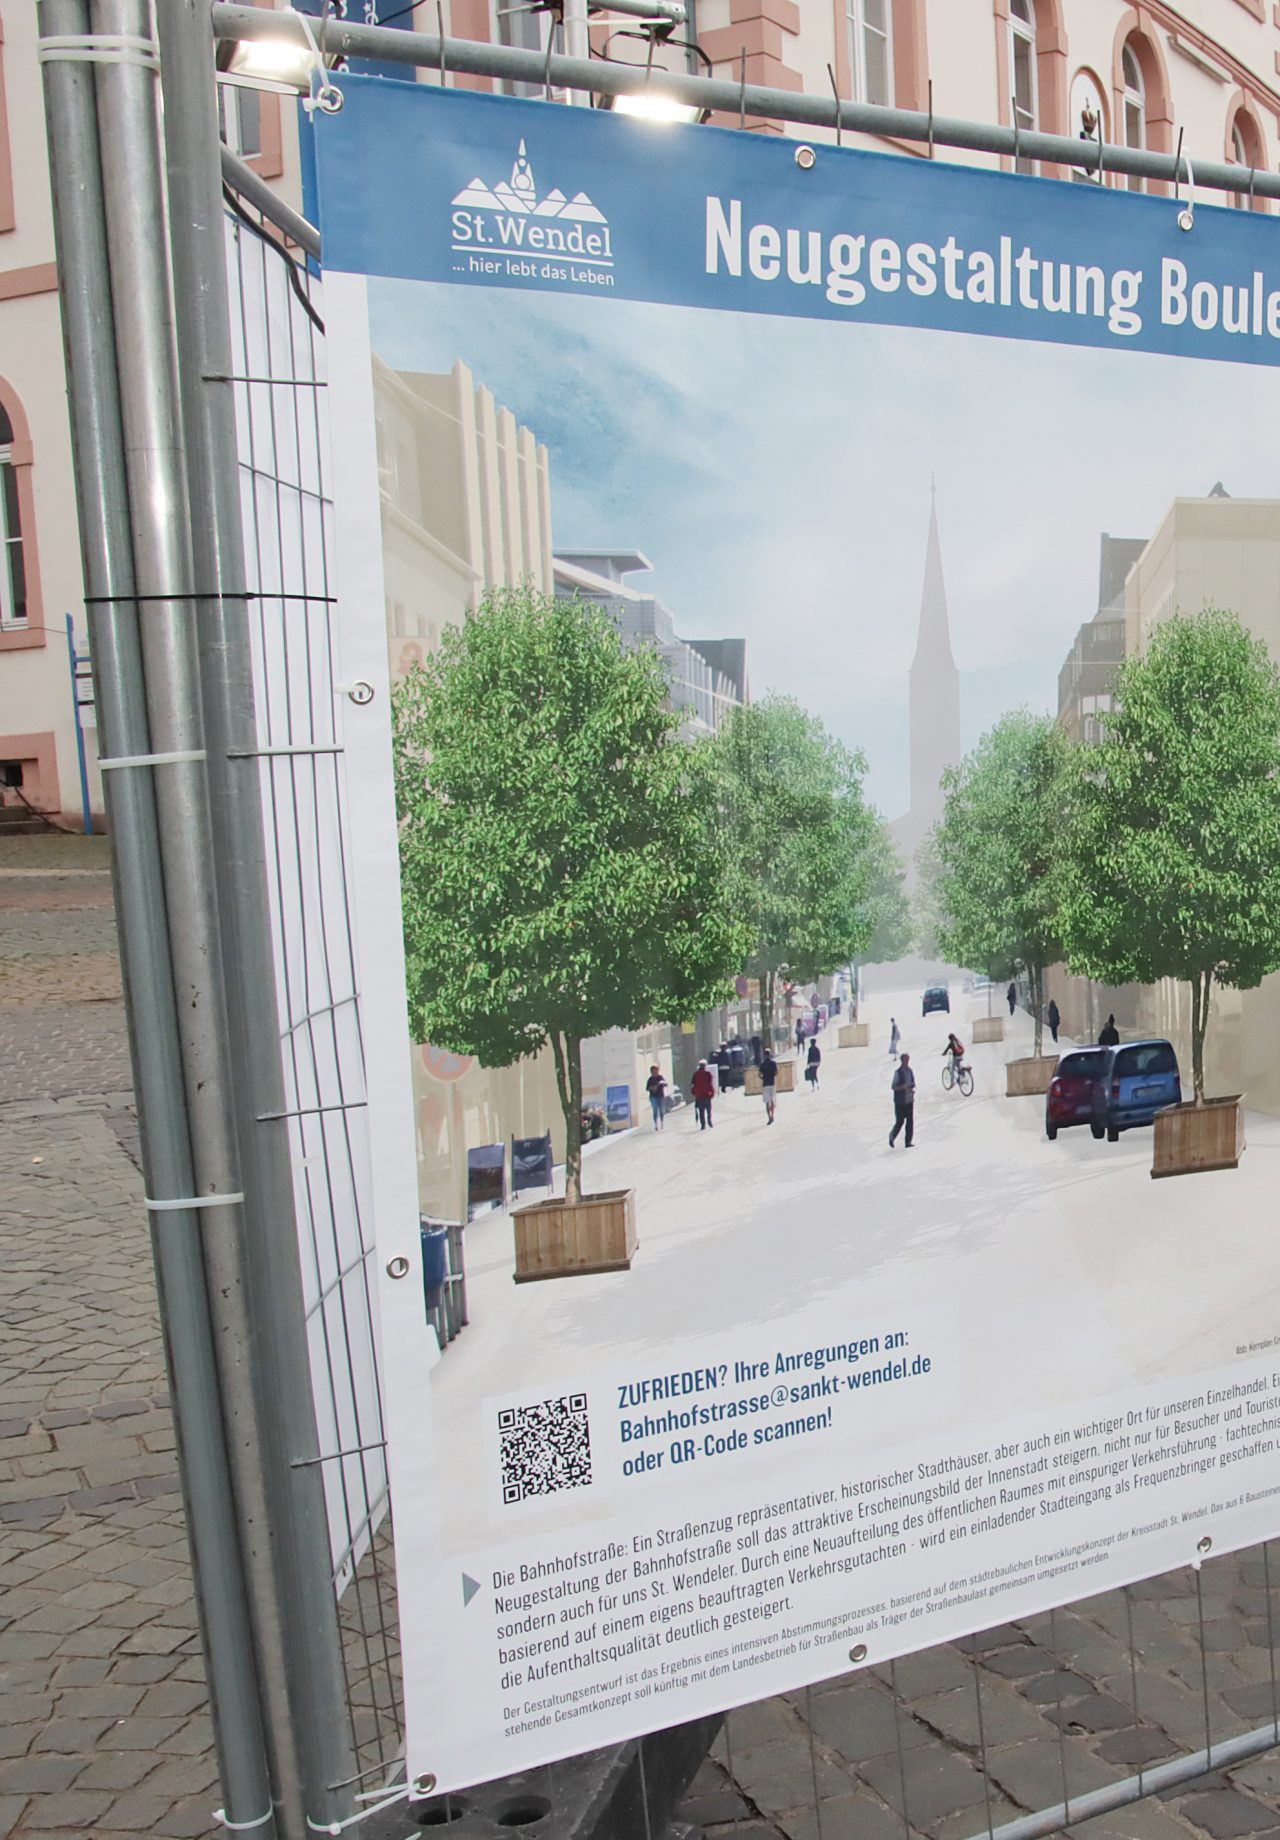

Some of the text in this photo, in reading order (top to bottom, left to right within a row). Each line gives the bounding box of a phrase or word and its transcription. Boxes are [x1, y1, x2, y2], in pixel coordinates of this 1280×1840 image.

[469, 256, 503, 274] hier
[506, 259, 537, 278] lebt
[540, 263, 568, 281] das
[570, 266, 615, 286] Leben
[706, 196, 1143, 336] Neugestaltung
[617, 1331, 909, 1409] ZUFRIEDEN? Ihre Anregungen an:
[620, 1353, 931, 1444] Bahnhofstrasse@sankt-wendel.de
[492, 1570, 516, 1590] Die
[519, 1542, 629, 1583] Bahnhofstraße:
[632, 1535, 653, 1554] Ein
[656, 1516, 734, 1547] Straßenzug
[841, 1469, 914, 1500] historischer
[994, 1443, 1020, 1461] aber
[1023, 1433, 1051, 1454] auch
[1053, 1429, 1071, 1446] ein
[1073, 1417, 1124, 1440] wichtiger
[1126, 1410, 1143, 1427] Ort
[1145, 1406, 1161, 1422] für
[1163, 1396, 1204, 1417] unseren
[622, 1405, 833, 1477] oder QR-Code scannen!
[494, 1575, 601, 1615] Neugestaltung
[605, 1567, 628, 1586] der
[633, 1538, 732, 1579] Bahnhofstraße
[736, 1529, 760, 1551] soll
[764, 1525, 788, 1544] das
[792, 1509, 854, 1537] attraktive
[857, 1477, 961, 1519] Erscheinungsbild
[964, 1474, 984, 1491] der
[987, 1456, 1049, 1485] Innenstadt
[1104, 1435, 1131, 1454] nicht
[1134, 1431, 1152, 1446] nur
[1155, 1425, 1170, 1441] für
[1174, 1412, 1220, 1435] Besucher
[1223, 1403, 1243, 1422] und
[496, 1612, 556, 1640] sondern
[559, 1599, 594, 1623] auch
[597, 1595, 618, 1613] für
[622, 1588, 648, 1606] uns
[741, 1549, 780, 1574] Durch
[783, 1544, 810, 1563] eine
[812, 1521, 900, 1555] Neuaufteilung
[902, 1514, 924, 1531] des
[927, 1495, 997, 1524] öffentlichen
[999, 1482, 1045, 1505] Raumes
[1047, 1473, 1066, 1491] mit
[1068, 1459, 1129, 1486] einspuriger
[1131, 1435, 1217, 1468] Verkehrsführung
[498, 1629, 570, 1665] basierend
[574, 1622, 597, 1644] auf
[602, 1613, 645, 1637] einem
[649, 1600, 695, 1624] eigens
[698, 1575, 785, 1610] beauftragten
[788, 1542, 907, 1585] Verkehrsgutachten
[919, 1527, 946, 1549] wird
[949, 1524, 967, 1541] ein
[970, 1505, 1036, 1536] einladender
[1039, 1485, 1112, 1516] Stadteingang
[1115, 1478, 1131, 1495] als
[1133, 1456, 1216, 1490] Frequenzbringer
[1219, 1440, 1274, 1469] geschaffen
[500, 1670, 523, 1690] die
[527, 1632, 662, 1683] Aufenthaltsqualität
[665, 1615, 720, 1644] deutlich
